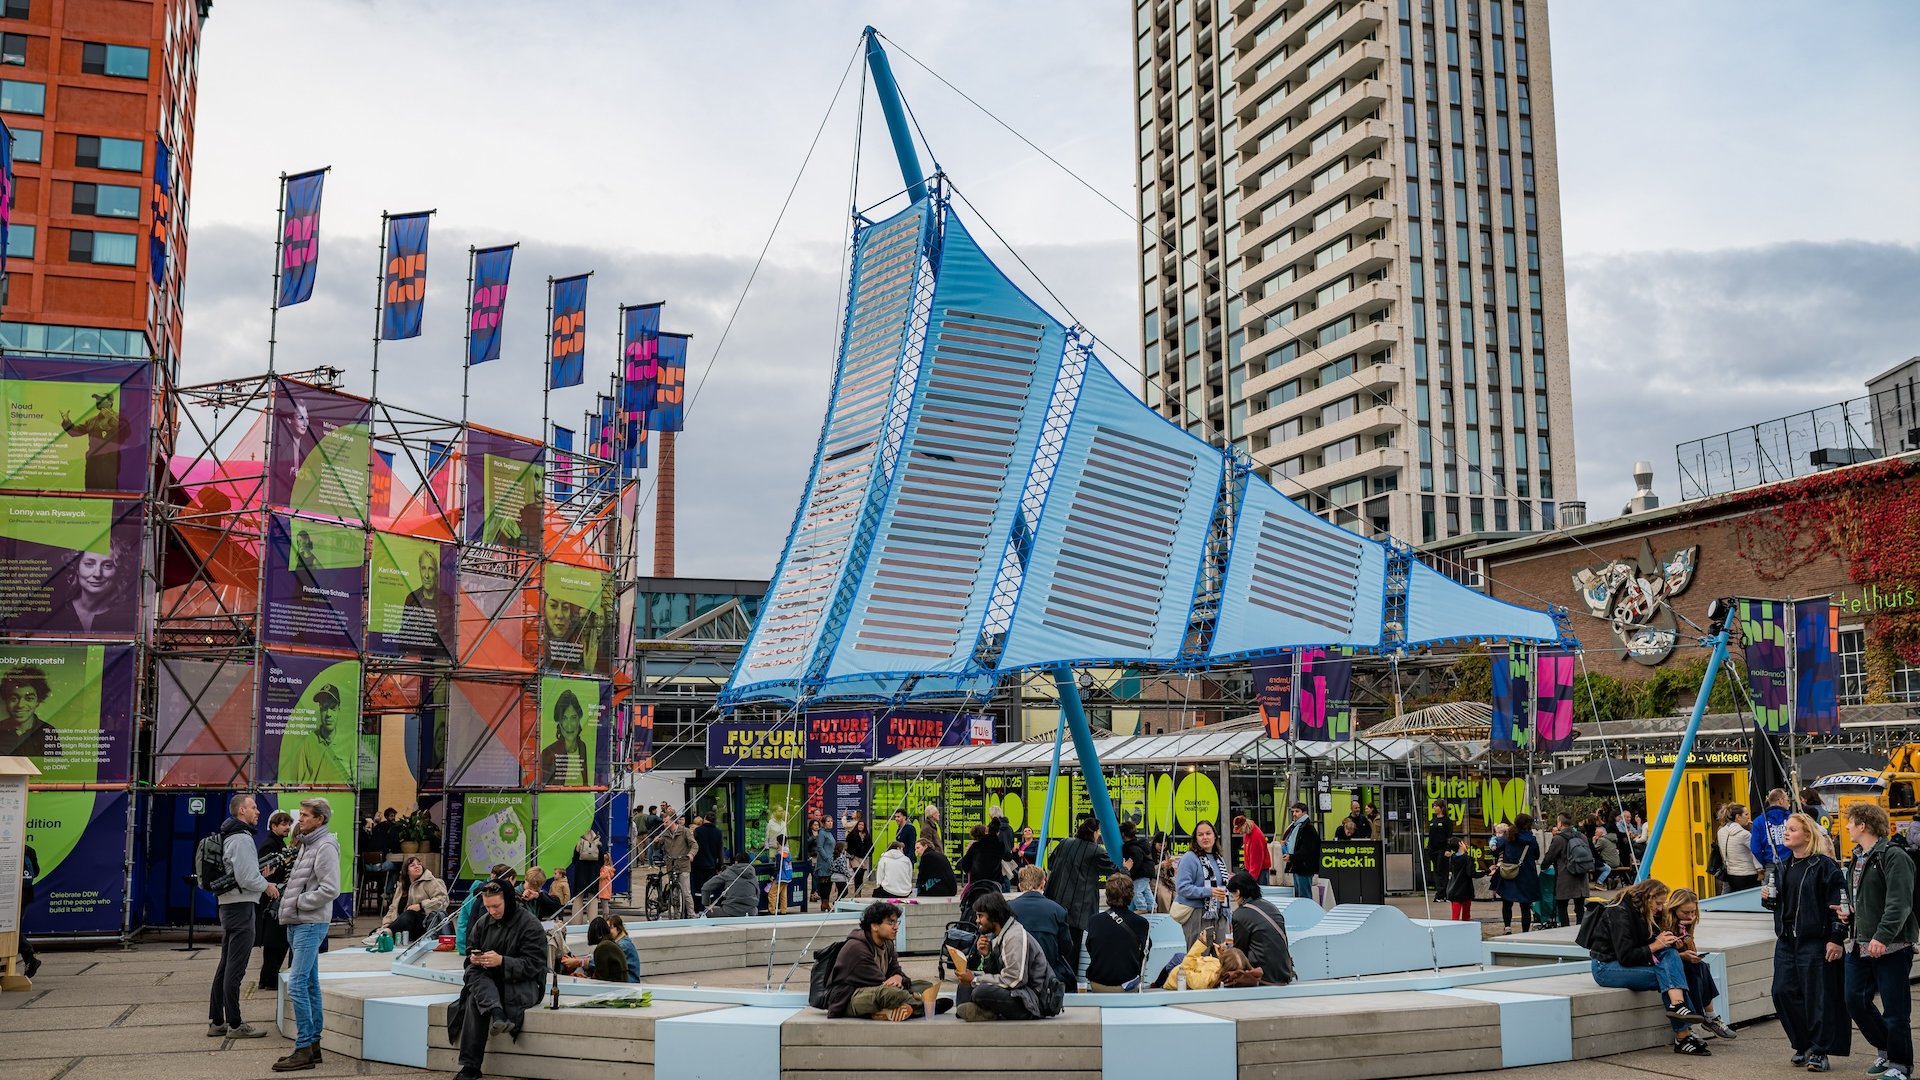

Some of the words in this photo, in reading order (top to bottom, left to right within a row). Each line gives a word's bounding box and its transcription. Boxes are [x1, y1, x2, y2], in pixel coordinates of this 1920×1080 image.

[11, 402, 33, 410] Noud
[10, 411, 44, 419] Sleumer
[10, 508, 34, 516] Lonny
[51, 509, 86, 518] Ryswyck
[303, 585, 330, 595] Frederique
[1839, 584, 1915, 613] telhuis
[0, 656, 19, 665] obby
[20, 656, 65, 666] Bompetshi
[812, 718, 869, 732] FUTURE
[890, 717, 943, 737] FUTURE
[973, 726, 990, 737] TU/e
[809, 732, 819, 740] BY
[820, 732, 866, 744] DESIGN
[886, 735, 897, 745] BY
[897, 736, 942, 750] DESIGN
[723, 746, 737, 754] BY
[738, 746, 804, 759] DESIGN
[820, 745, 837, 754] TU/e
[1103, 775, 1130, 788] losing
[1130, 774, 1145, 786] the
[1827, 775, 1870, 784] ROCHO
[906, 779, 942, 797] Unfair
[1427, 776, 1478, 799] Unfair
[467, 796, 523, 804] KETELHUISPLEIN
[1427, 799, 1466, 826] Pay
[26, 819, 62, 829] dition
[1173, 842, 1191, 856] Unfai
[1321, 856, 1363, 868] Check
[1364, 856, 1376, 868] in
[50, 891, 82, 899] Celebrate
[74, 899, 97, 907] people
[49, 906, 66, 914] build
